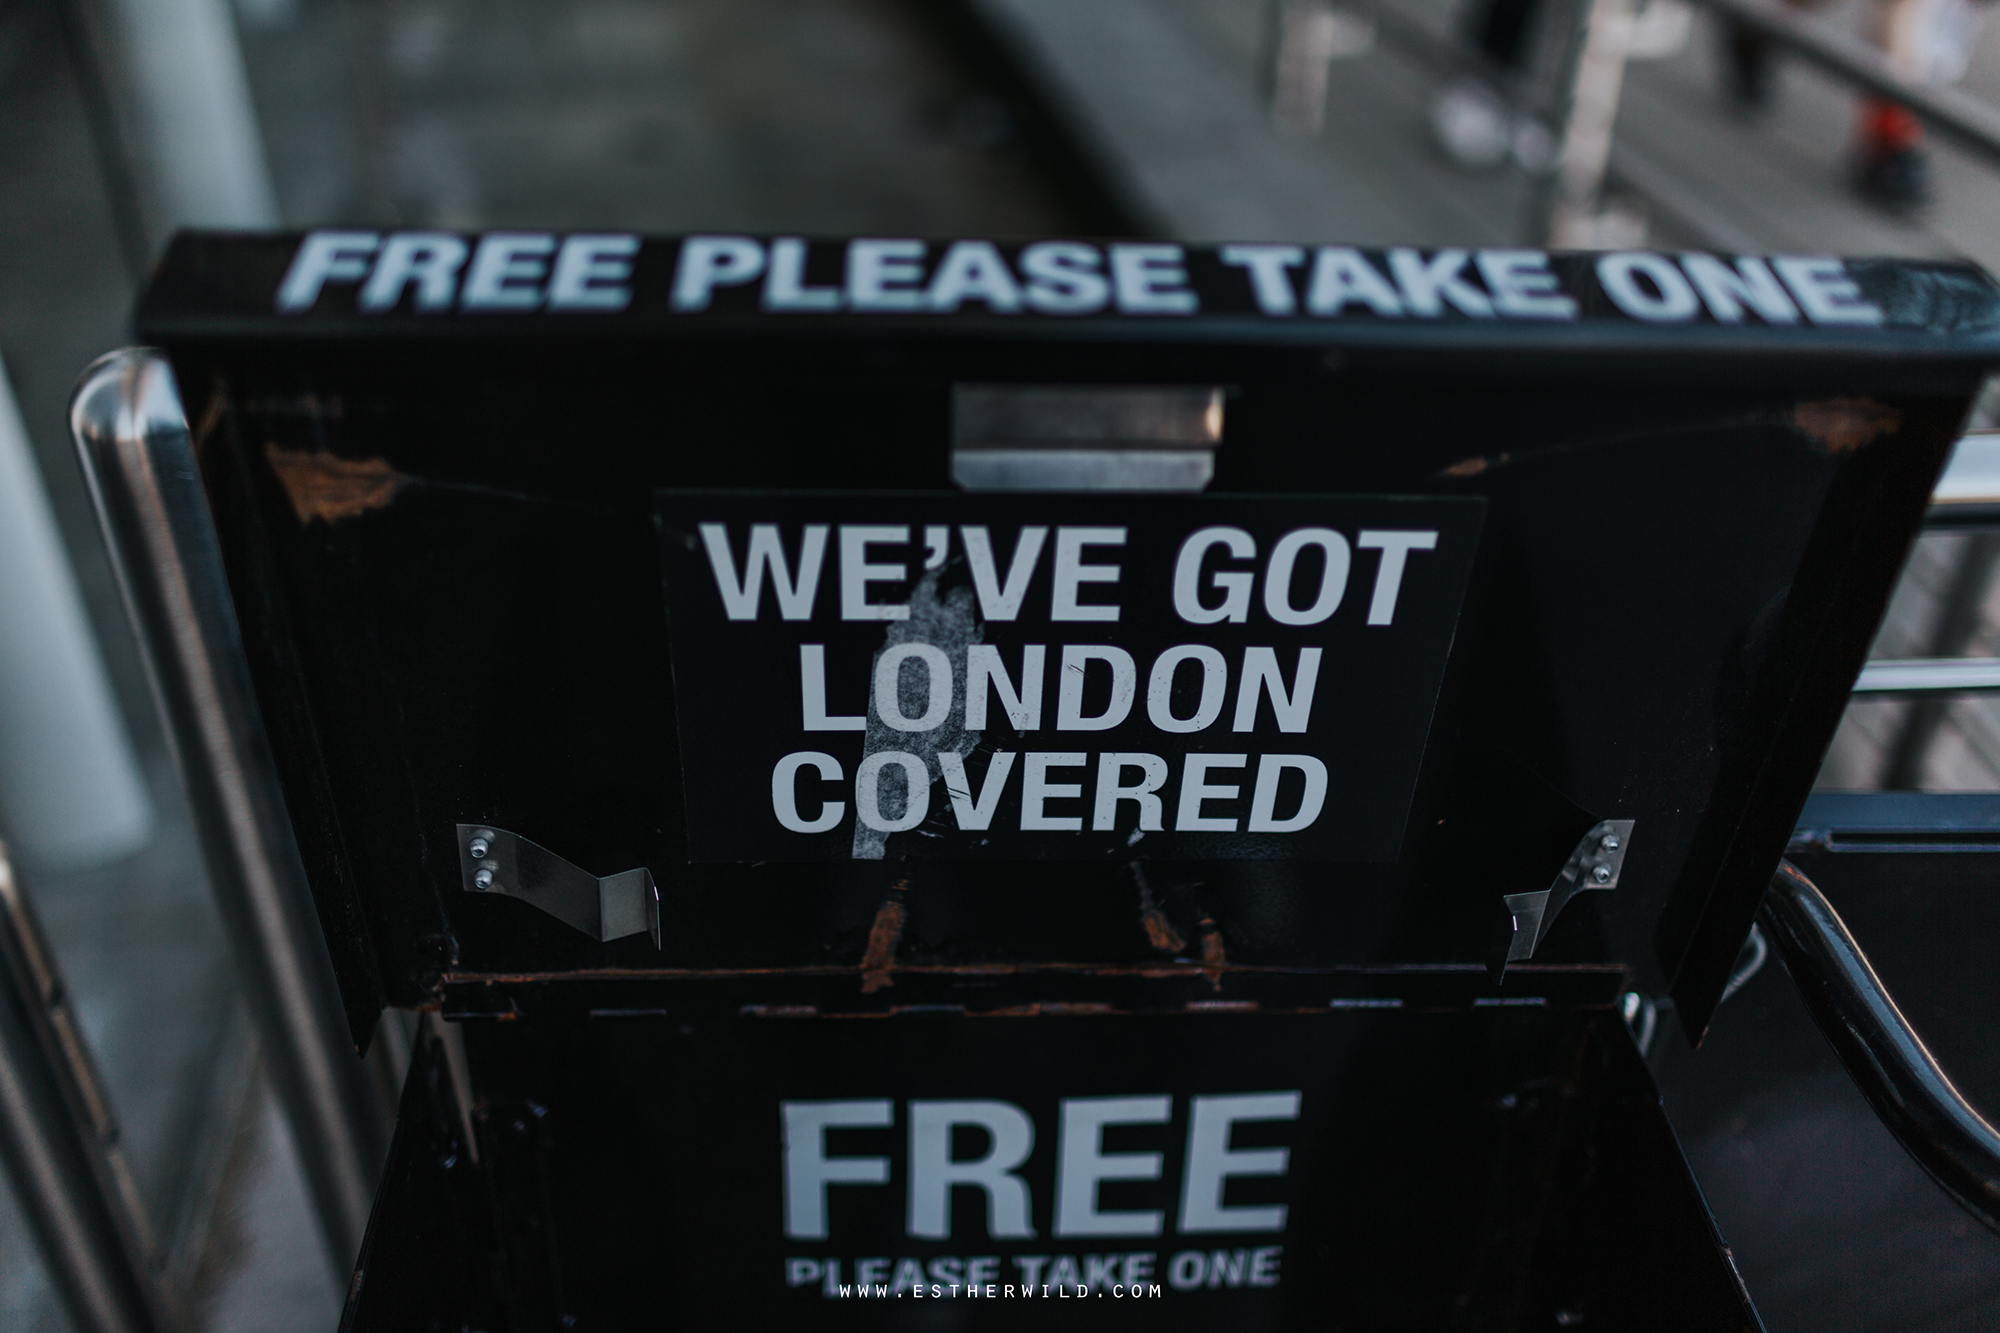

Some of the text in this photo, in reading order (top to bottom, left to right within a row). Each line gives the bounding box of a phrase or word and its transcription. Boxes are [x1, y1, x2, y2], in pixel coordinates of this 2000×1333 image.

[277, 231, 1884, 327] FREE PLEASE TAKE ONE
[699, 523, 1439, 626] WE'VE GOT
[800, 642, 1323, 734] LONDON
[771, 751, 1330, 834] COVERED
[781, 1091, 1302, 1241] FREE
[785, 1245, 1284, 1297] PLEASE TAKE ONE
